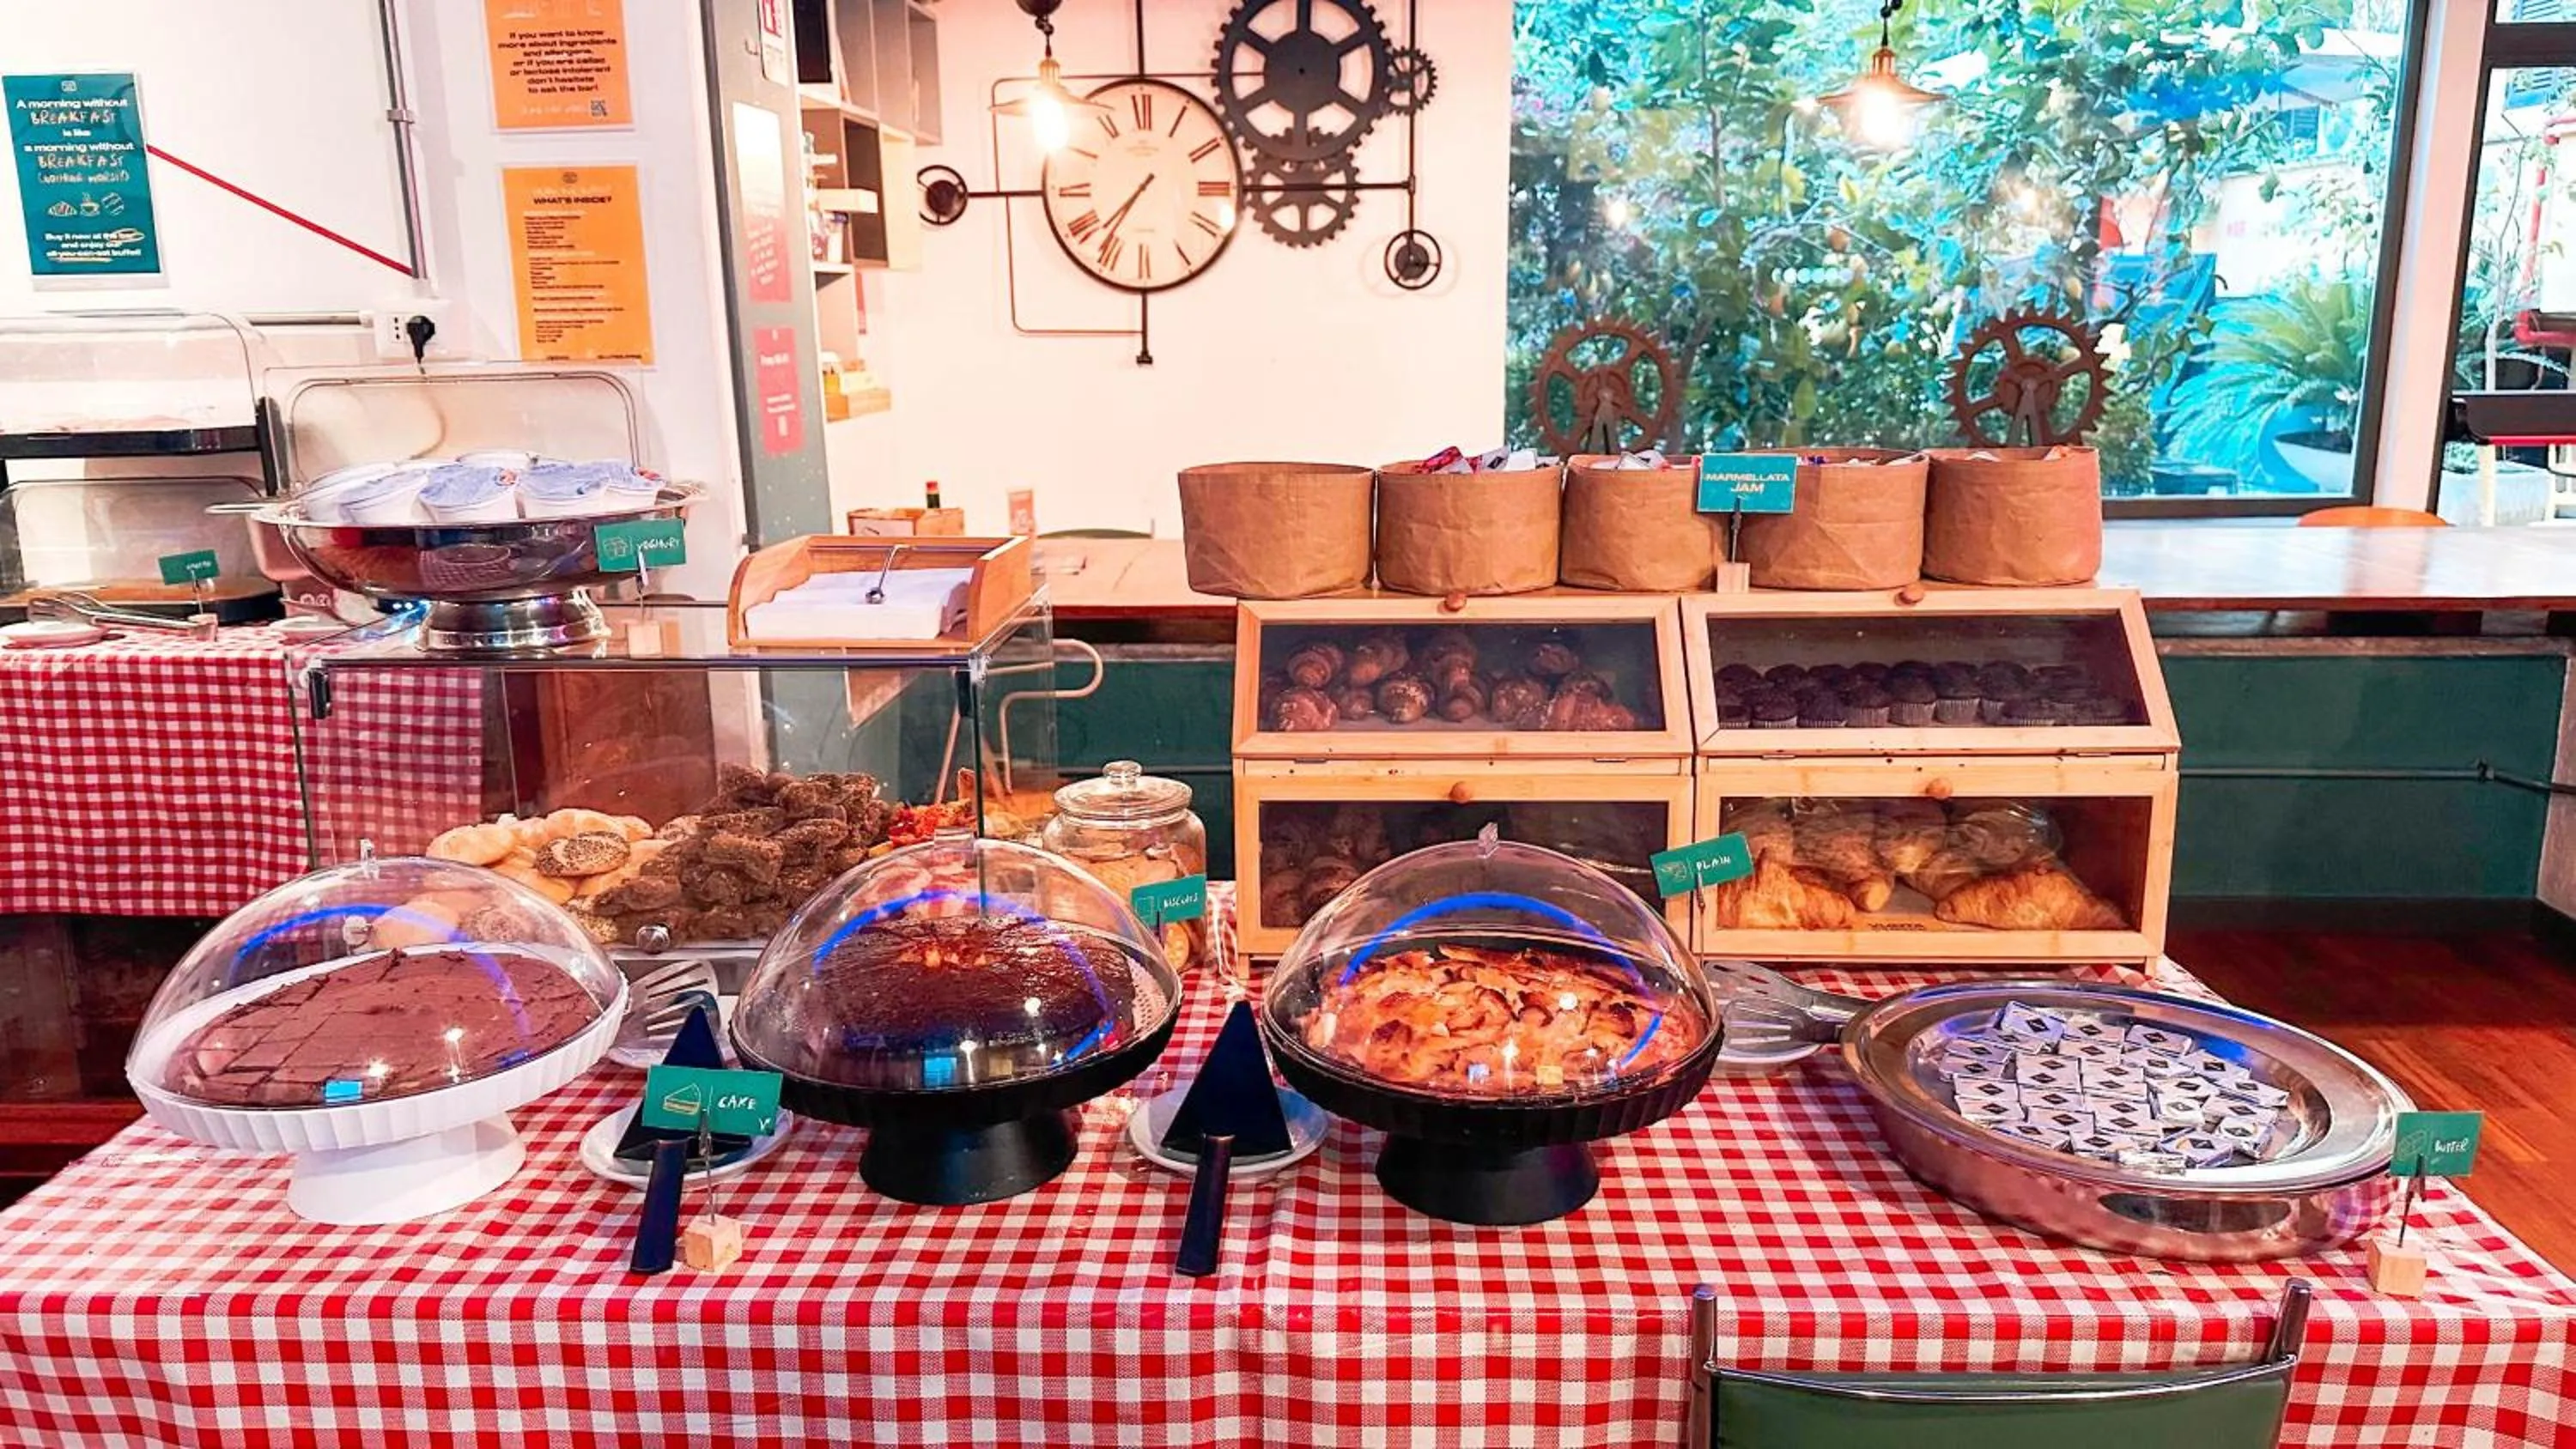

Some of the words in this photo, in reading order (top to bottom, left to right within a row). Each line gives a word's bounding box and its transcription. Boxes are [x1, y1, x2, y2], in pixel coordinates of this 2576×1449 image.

[559, 38, 617, 47] ingredients
[16, 99, 27, 108] A
[28, 99, 81, 110] morning
[83, 98, 129, 108] without
[30, 110, 116, 125] BREAKFAST
[34, 142, 87, 154] morning
[88, 142, 135, 152] without
[38, 154, 125, 169] BREAKFAST
[1705, 472, 1790, 482] MARMELLATA
[1729, 482, 1765, 494] JAM
[1696, 854, 1731, 871] PLAIN
[717, 1094, 757, 1111] CAKE
